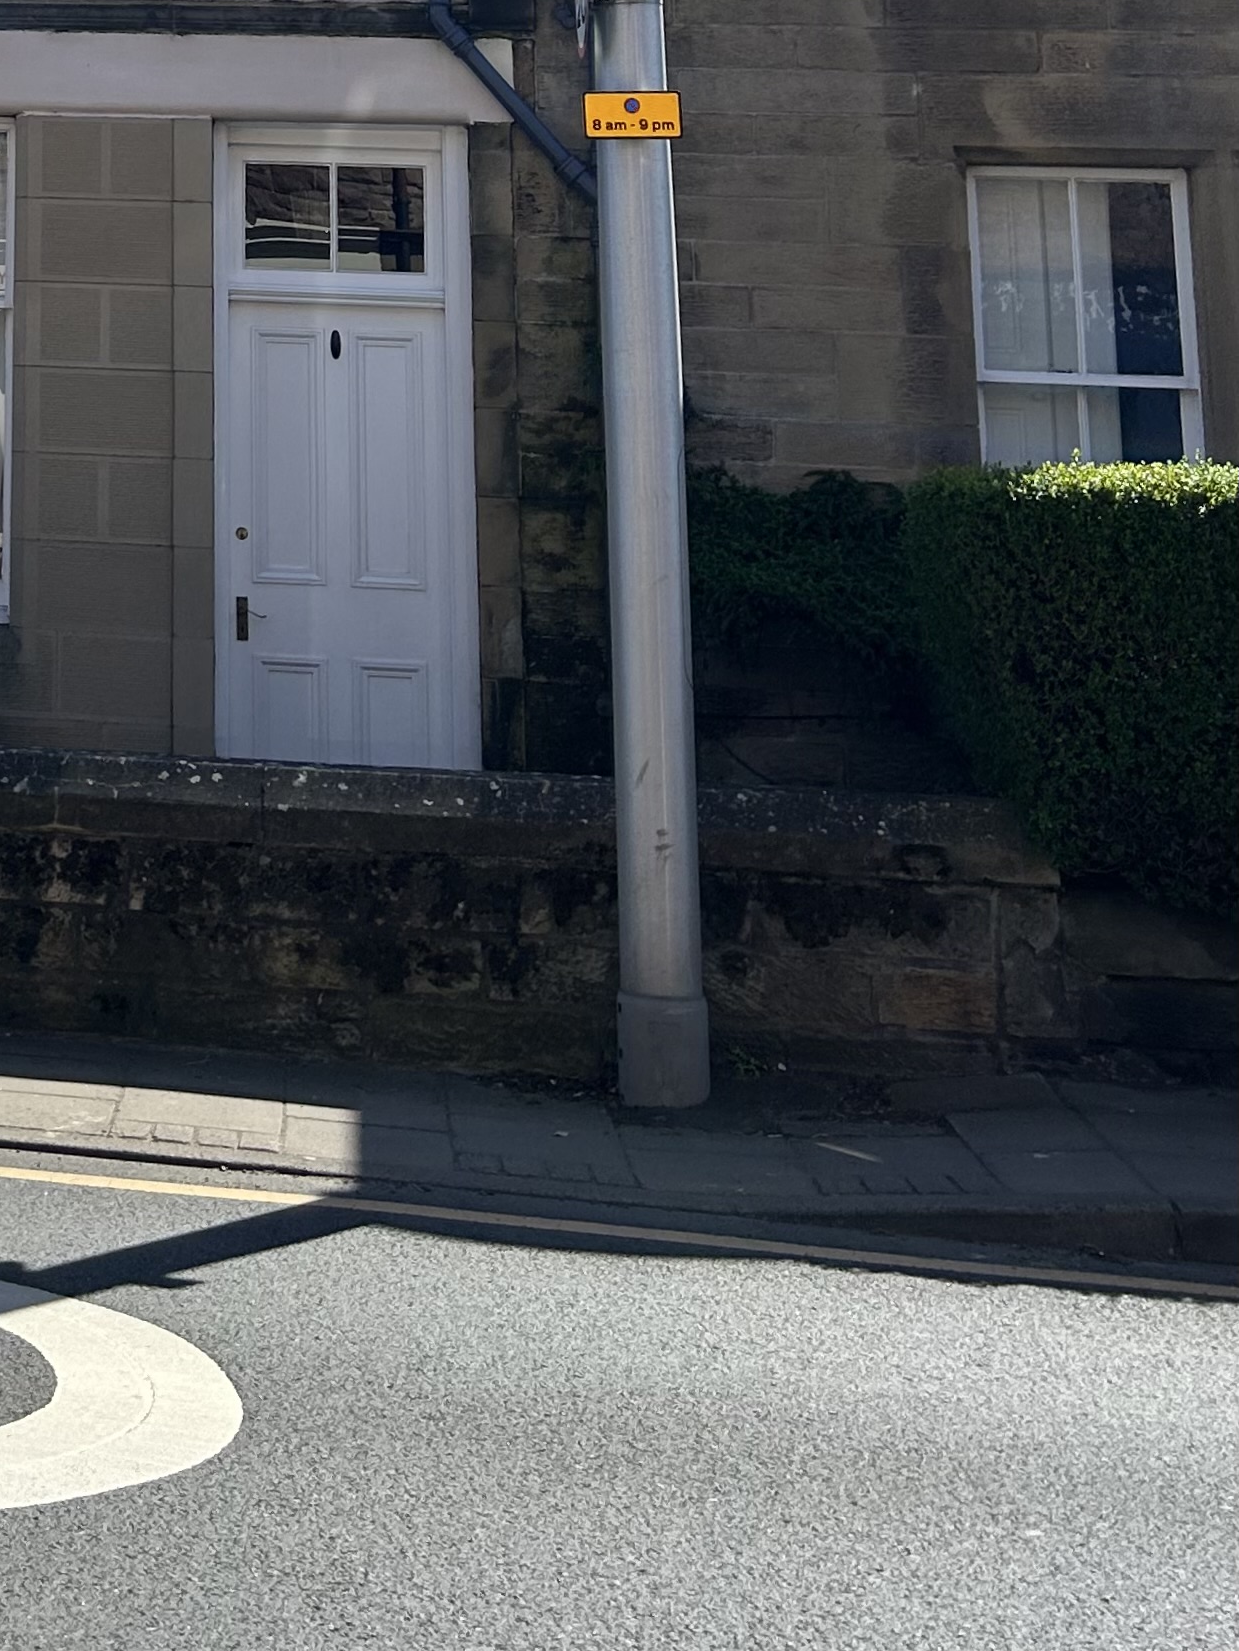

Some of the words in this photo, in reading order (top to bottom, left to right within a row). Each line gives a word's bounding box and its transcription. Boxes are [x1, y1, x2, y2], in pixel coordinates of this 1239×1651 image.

[592, 119, 601, 131] 8
[606, 121, 627, 131] am
[639, 119, 648, 131] 9
[652, 121, 675, 132] pm
